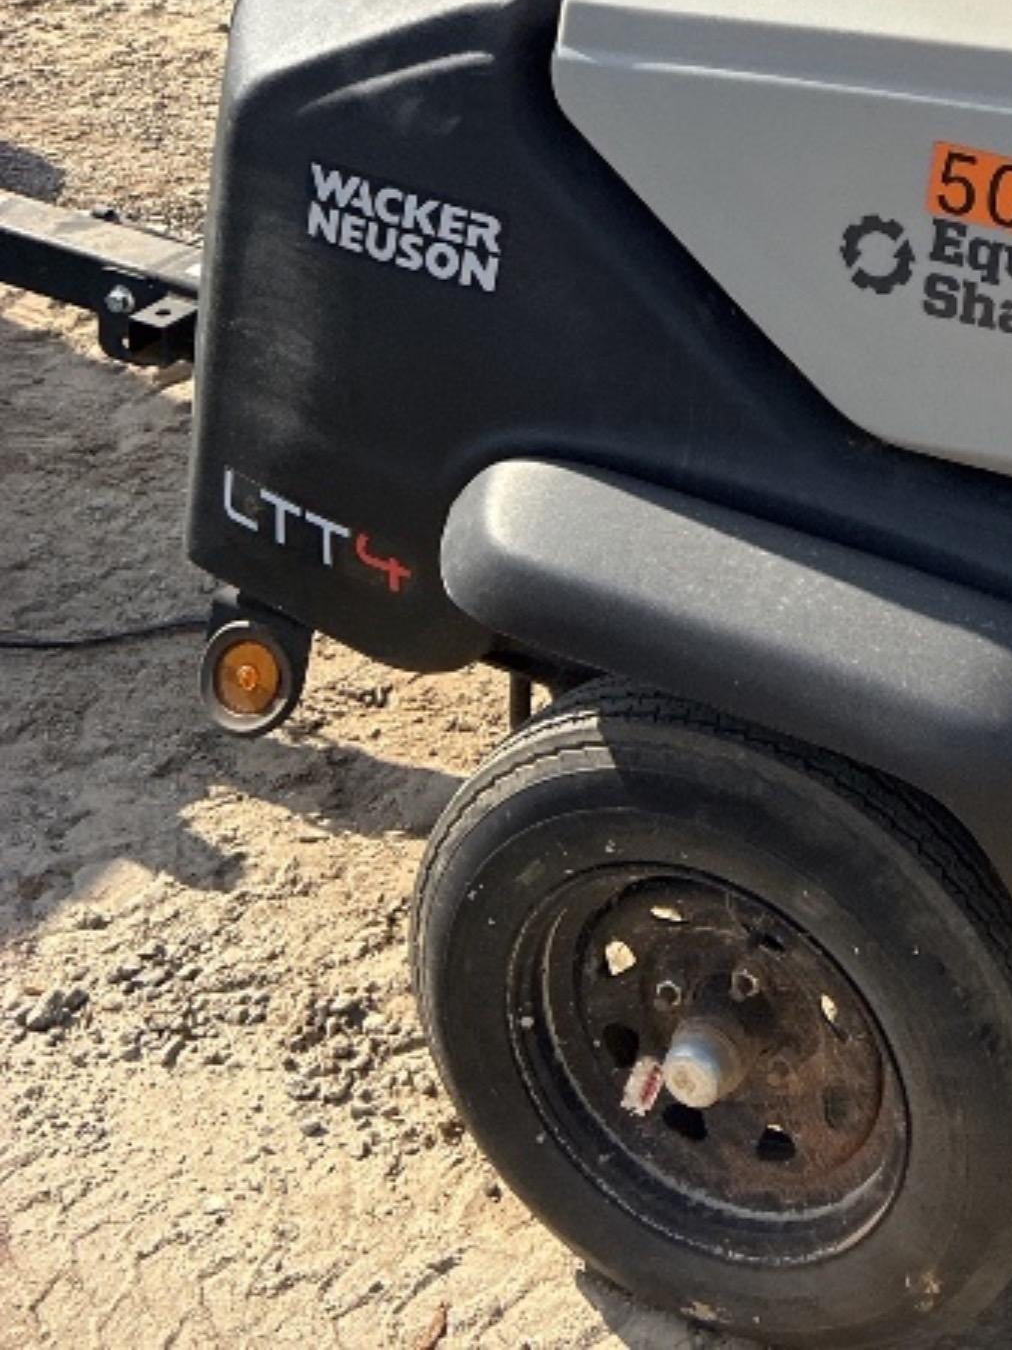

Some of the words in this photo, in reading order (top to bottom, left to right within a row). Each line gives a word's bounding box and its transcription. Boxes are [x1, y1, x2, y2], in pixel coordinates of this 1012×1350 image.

[307, 203, 501, 293] NEUSON
[310, 161, 503, 254] WACKER
[222, 468, 412, 593] LTT4
